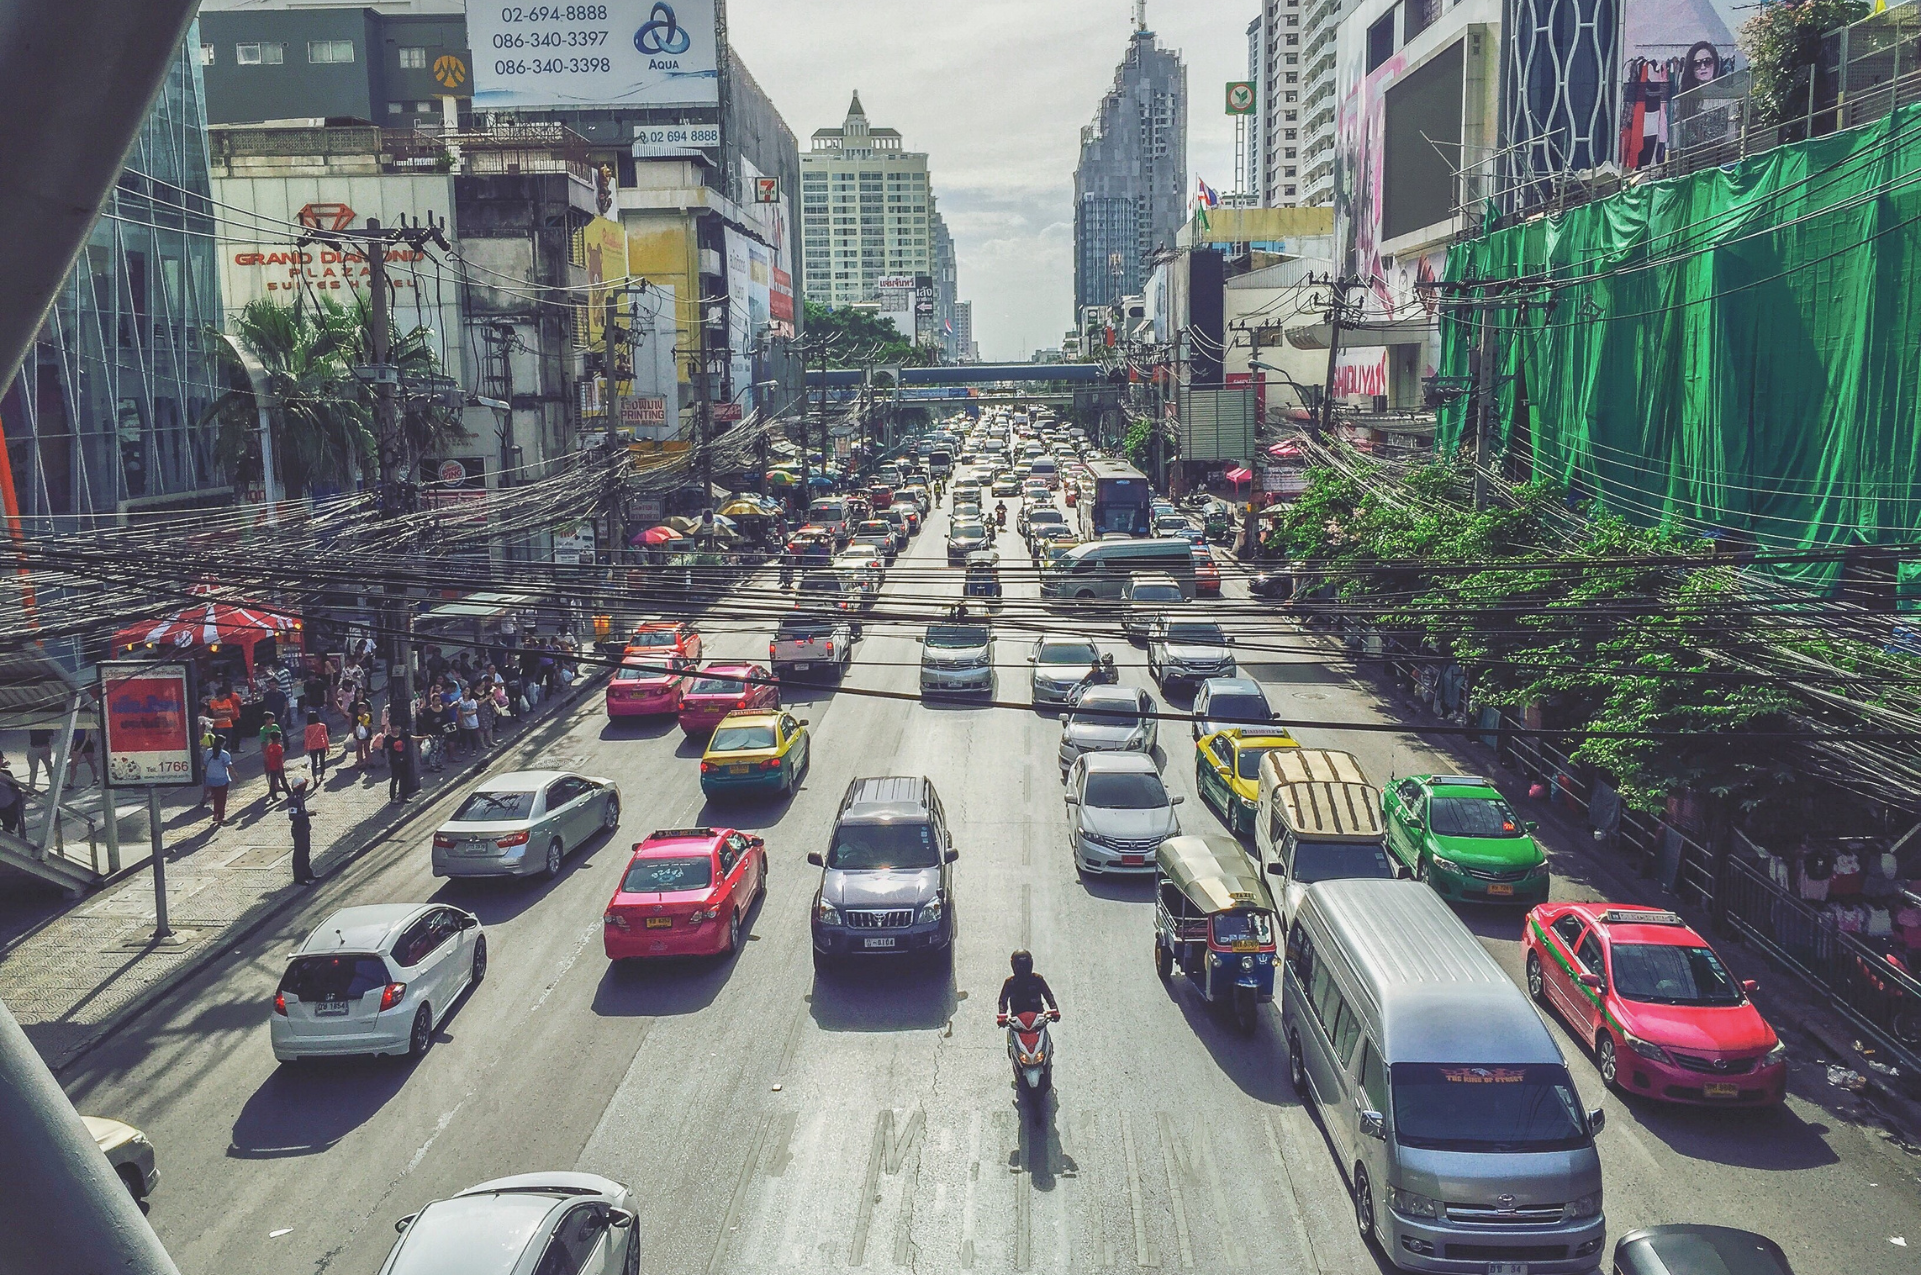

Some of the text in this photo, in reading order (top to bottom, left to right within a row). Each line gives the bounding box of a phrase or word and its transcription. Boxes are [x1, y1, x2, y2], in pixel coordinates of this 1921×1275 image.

[502, 5, 608, 22] 02-694-8888
[493, 31, 609, 49] 086-340-3397
[495, 57, 611, 75] 086-340-3398
[649, 59, 680, 70] AQUA
[650, 130, 718, 143] 02 694 8888
[235, 250, 425, 266] GRAND DIAOND
[289, 267, 372, 278] PLAZA
[351, 280, 416, 289] HEL
[620, 410, 665, 420] PRINTING
[159, 761, 189, 773] 1766
[1463, 1075, 1482, 1083] KING
